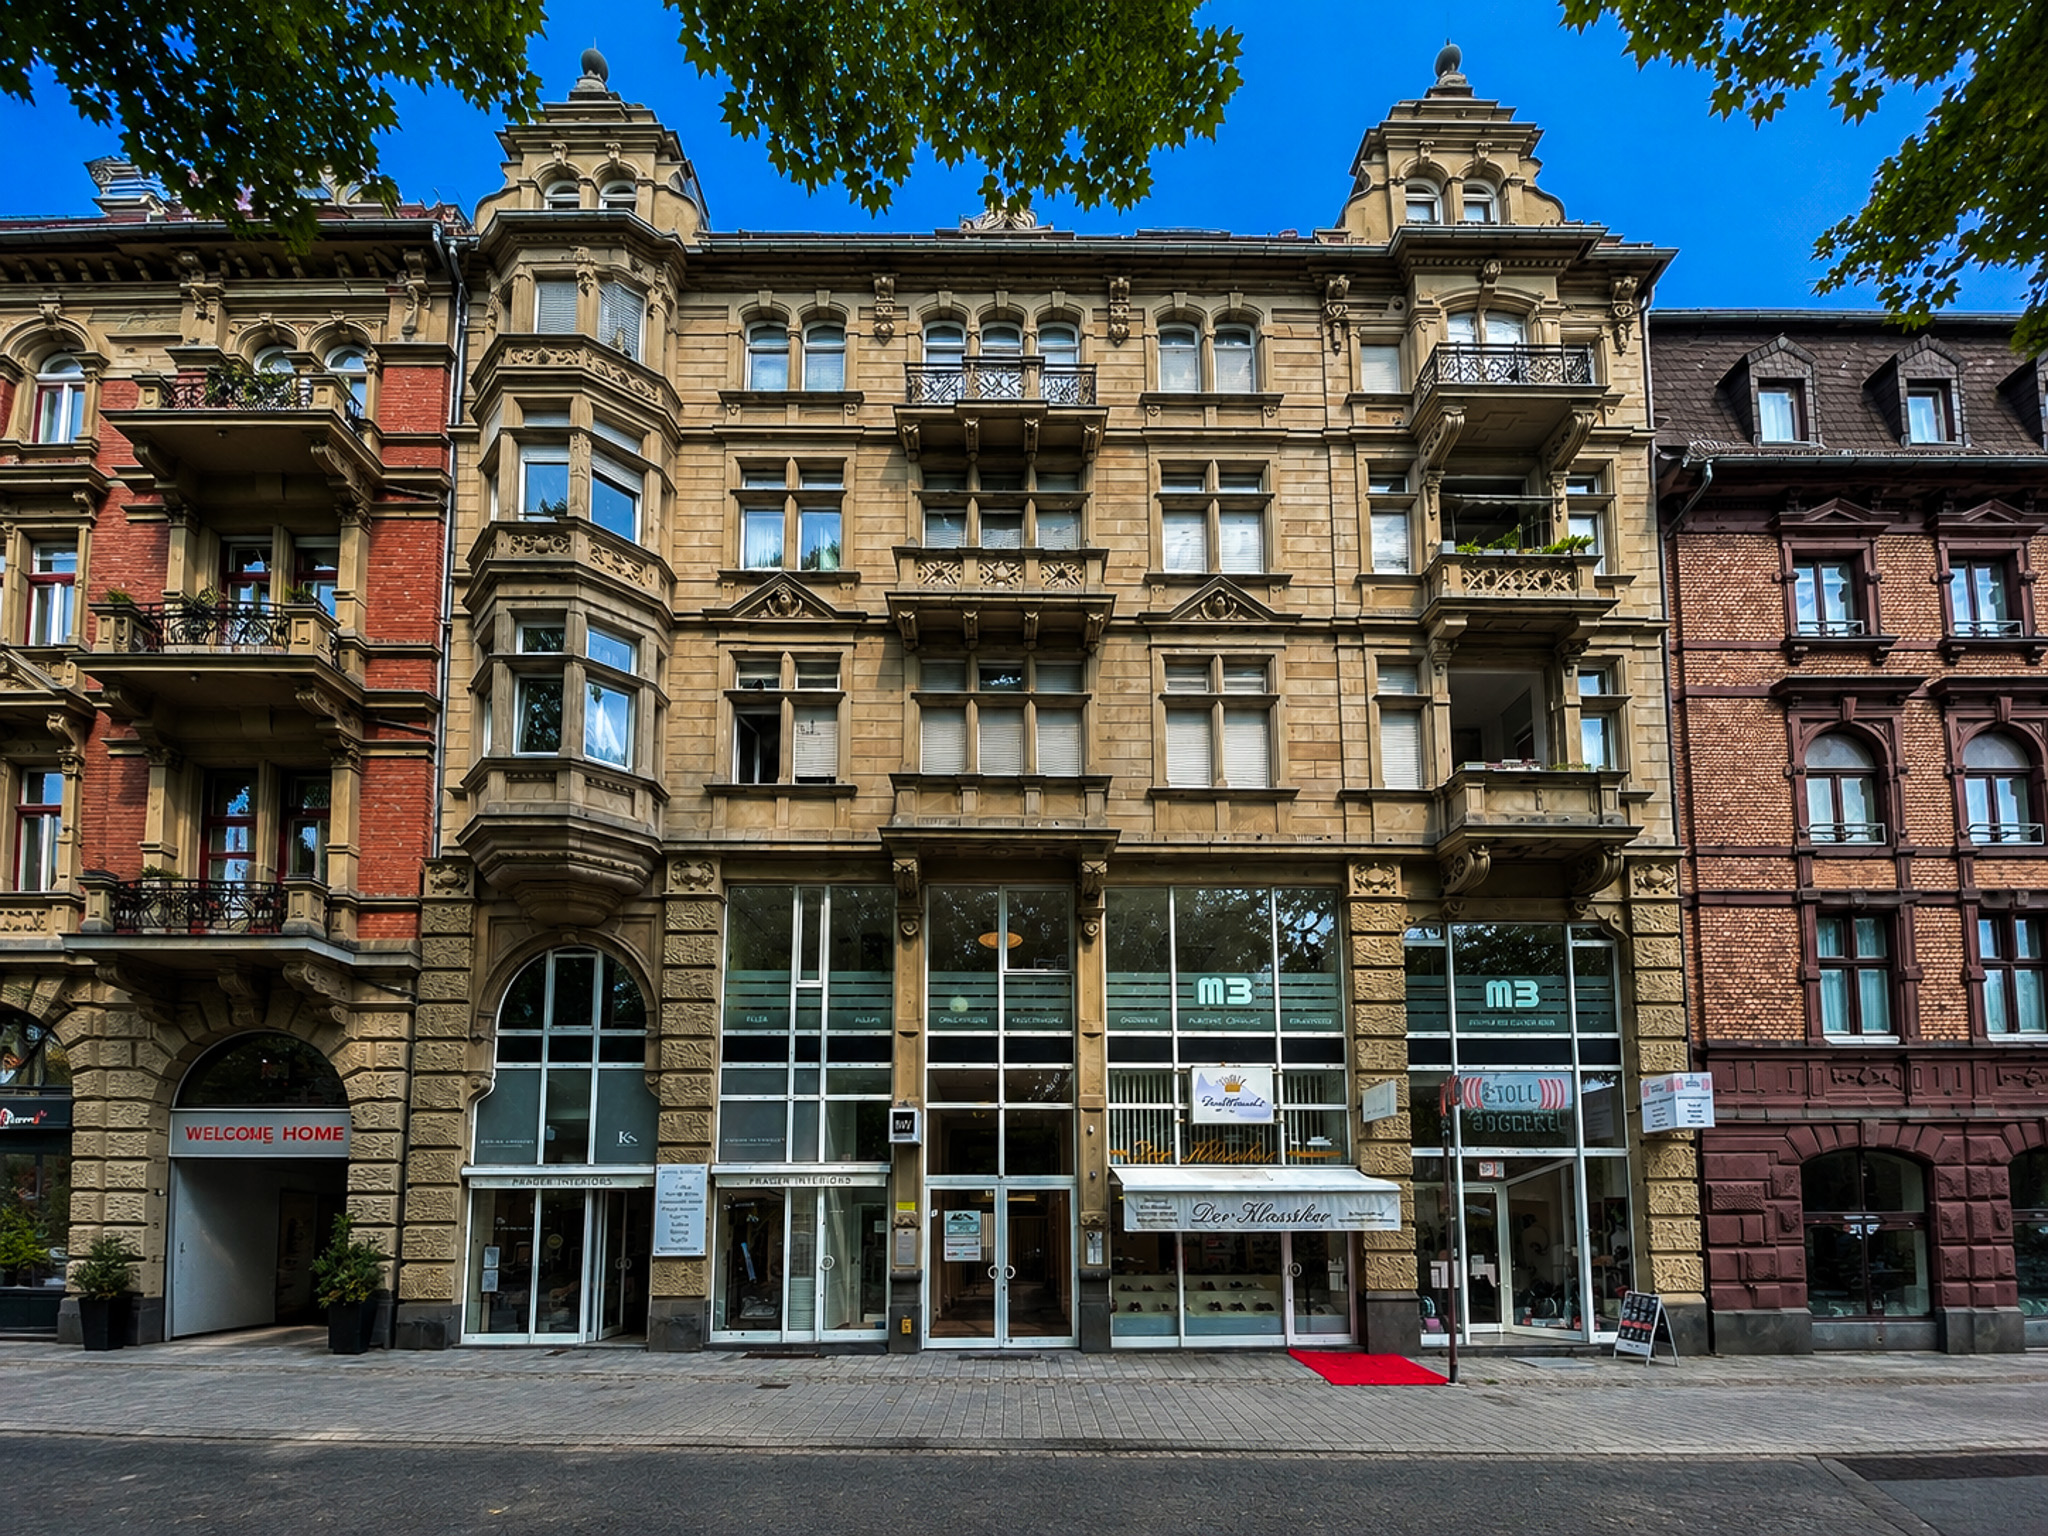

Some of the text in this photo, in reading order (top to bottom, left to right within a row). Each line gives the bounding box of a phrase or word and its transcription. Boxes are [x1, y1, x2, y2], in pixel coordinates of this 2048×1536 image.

[1198, 977, 1252, 1005] M3
[1486, 979, 1539, 1008] M3
[282, 1126, 345, 1141] HOME
[1191, 1201, 1228, 1223] Der
